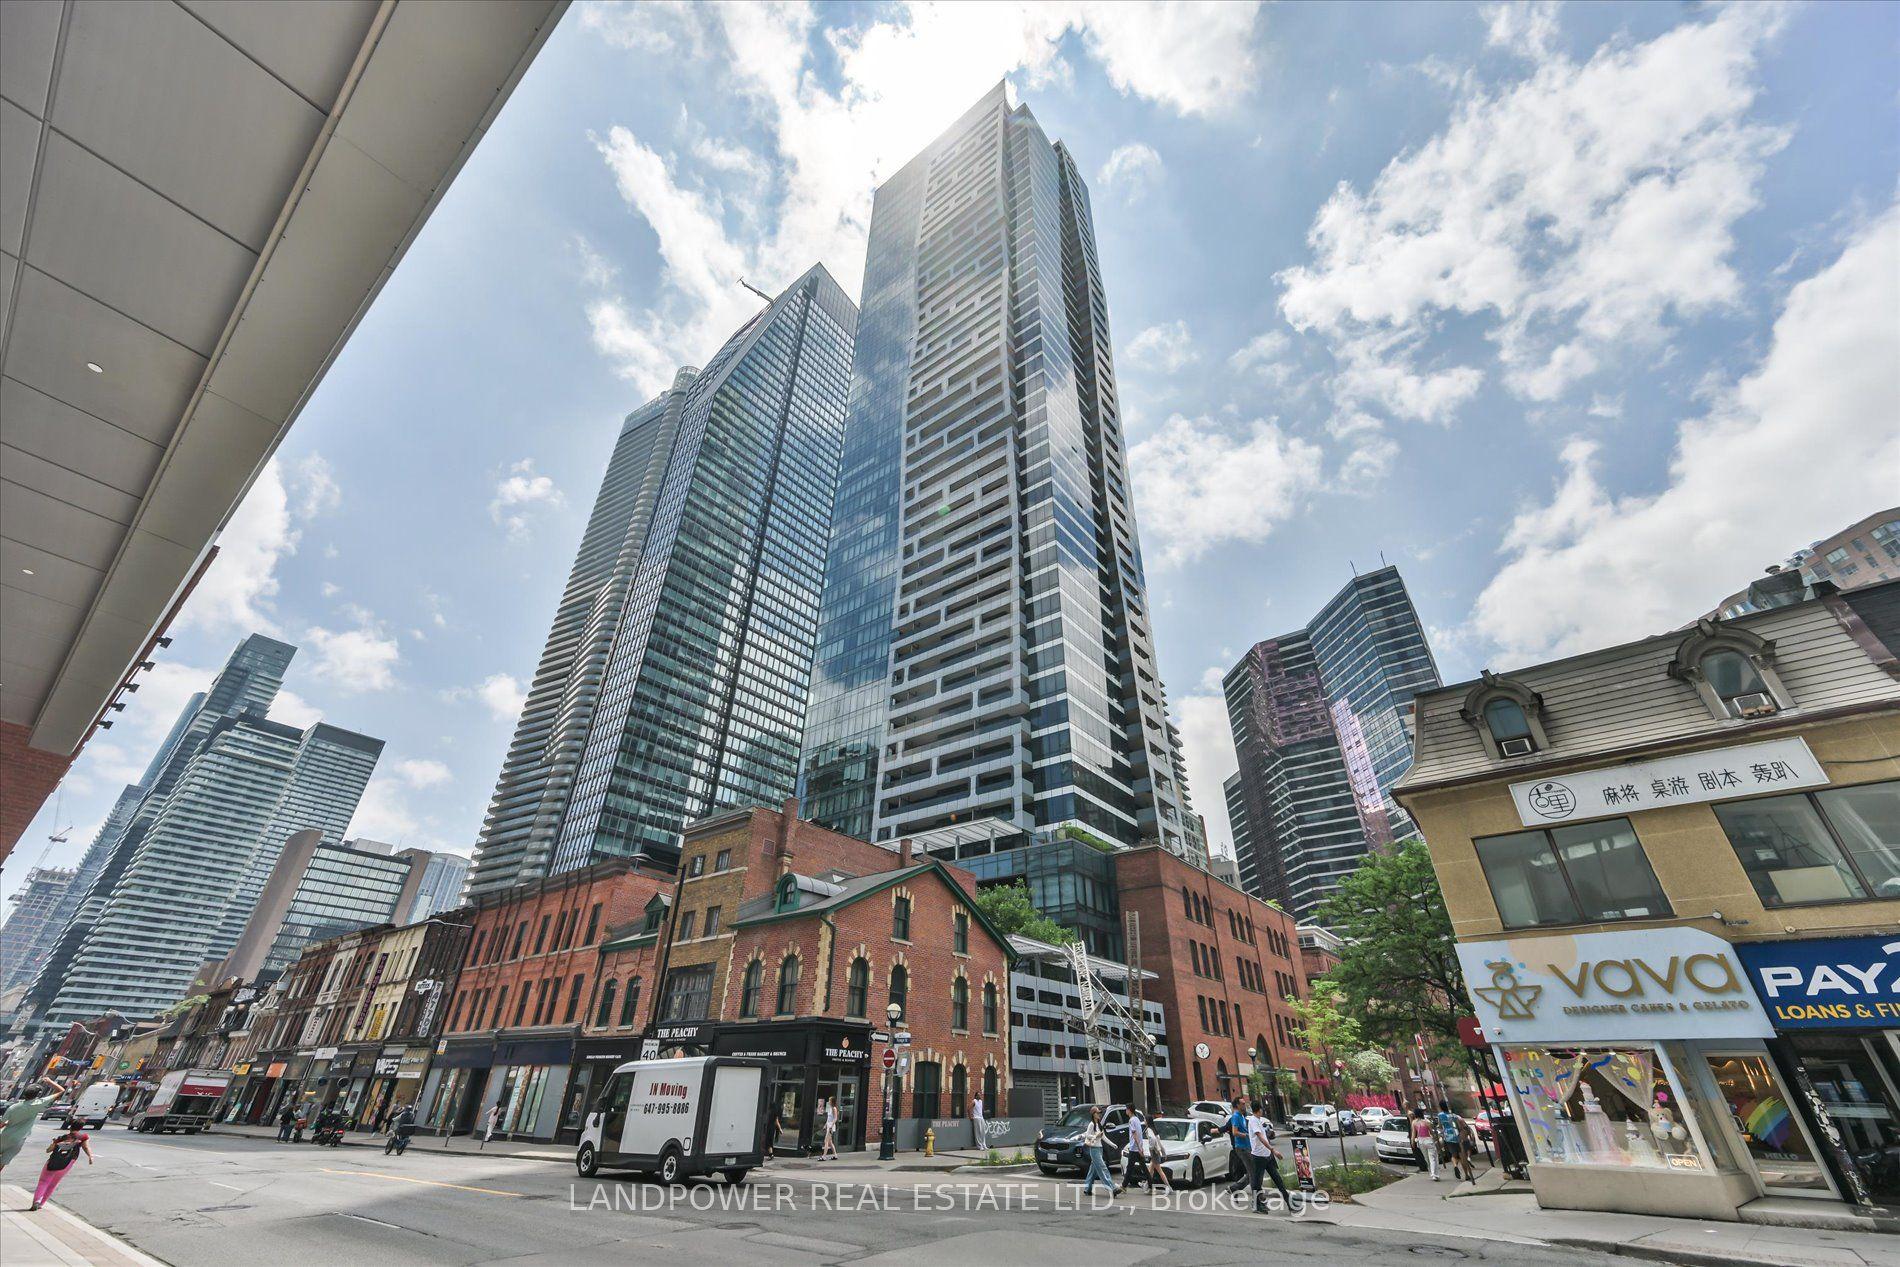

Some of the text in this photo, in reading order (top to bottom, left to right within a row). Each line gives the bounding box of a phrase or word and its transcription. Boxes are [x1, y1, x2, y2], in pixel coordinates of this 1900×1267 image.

[1602, 760, 1800, 806] 麻将 桌游 剧本 轰趴
[1563, 1000, 1750, 1016] DESIGNER CAKES & GELATO
[1775, 1004, 1852, 1020] LOANS
[1855, 1003, 1875, 1018] &
[657, 1026, 699, 1038] THE PEACHY
[642, 1049, 657, 1060] 40
[825, 1048, 864, 1059] THE PEACHY
[659, 1083, 688, 1100] Moving
[1763, 1152, 1799, 1160] HELLO
[1671, 1158, 1698, 1168] OPEN
